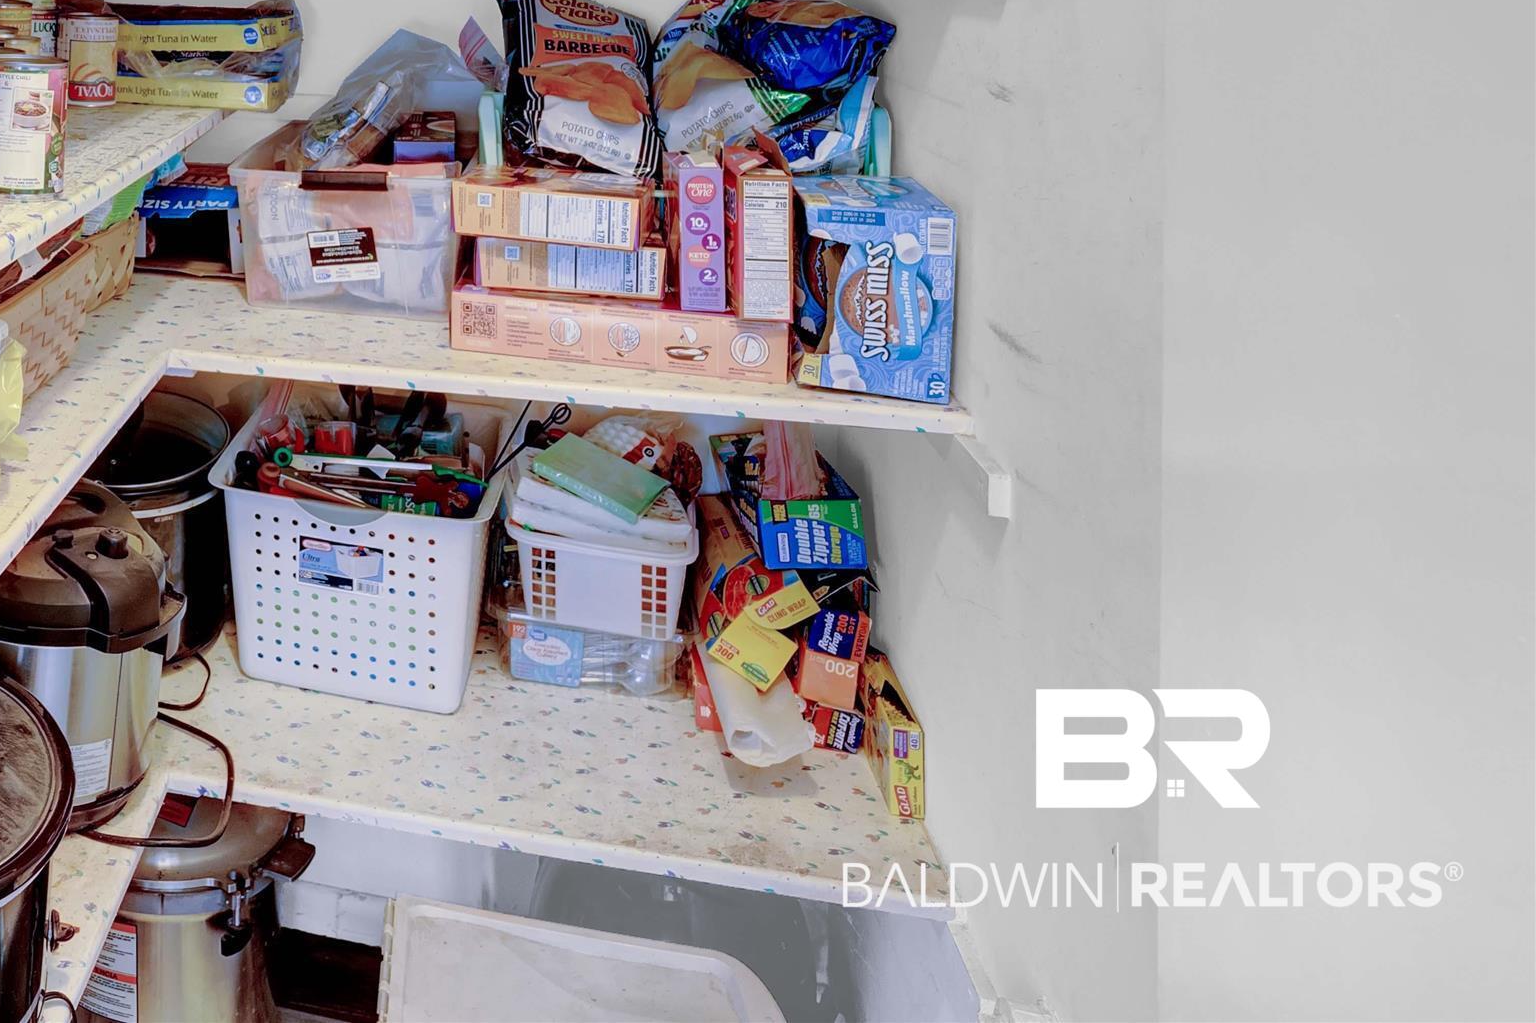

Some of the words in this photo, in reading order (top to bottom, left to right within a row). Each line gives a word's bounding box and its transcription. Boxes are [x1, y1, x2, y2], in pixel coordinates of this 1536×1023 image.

[554, 8, 612, 23] Flake
[155, 34, 179, 44] Tuna
[181, 34, 189, 43] in
[190, 34, 218, 44] Water
[551, 30, 588, 41] SWEET
[544, 39, 631, 56] BARBECUE
[135, 85, 155, 97] Light
[192, 90, 218, 99] Water
[681, 116, 709, 139] POTATO
[710, 100, 734, 120] CHIPS
[562, 121, 594, 137] POTATO
[596, 130, 620, 146] CHIPS
[687, 183, 714, 191] PROTEIN
[744, 180, 769, 188] Nutrition
[171, 199, 230, 209] PARTY
[775, 201, 788, 209] 210
[597, 199, 605, 227] Calories
[622, 201, 630, 226] Nutrition
[621, 228, 629, 244] Facts
[650, 250, 658, 276] Nutrition
[688, 252, 711, 261] KETO
[865, 240, 894, 297] MISS
[648, 278, 656, 293] Facts
[900, 270, 916, 347] Marshmallow
[861, 299, 890, 362] SWISS
[803, 365, 815, 376] 30
[928, 381, 946, 397] 30
[809, 504, 820, 519] 65
[849, 503, 859, 529] GALLON
[795, 519, 812, 564] Double
[812, 521, 829, 564] Zipper
[830, 526, 843, 564] Storage
[767, 610, 787, 623] CLING
[788, 598, 807, 617] WRAP
[818, 612, 835, 650] Reynolds
[836, 615, 849, 633] 200
[715, 644, 734, 660] 300
[827, 632, 843, 655] Wrap
[825, 660, 856, 676] 200
[833, 713, 851, 750] CUT-RITE
[911, 738, 919, 749] 40
[896, 787, 912, 815] GLAD
